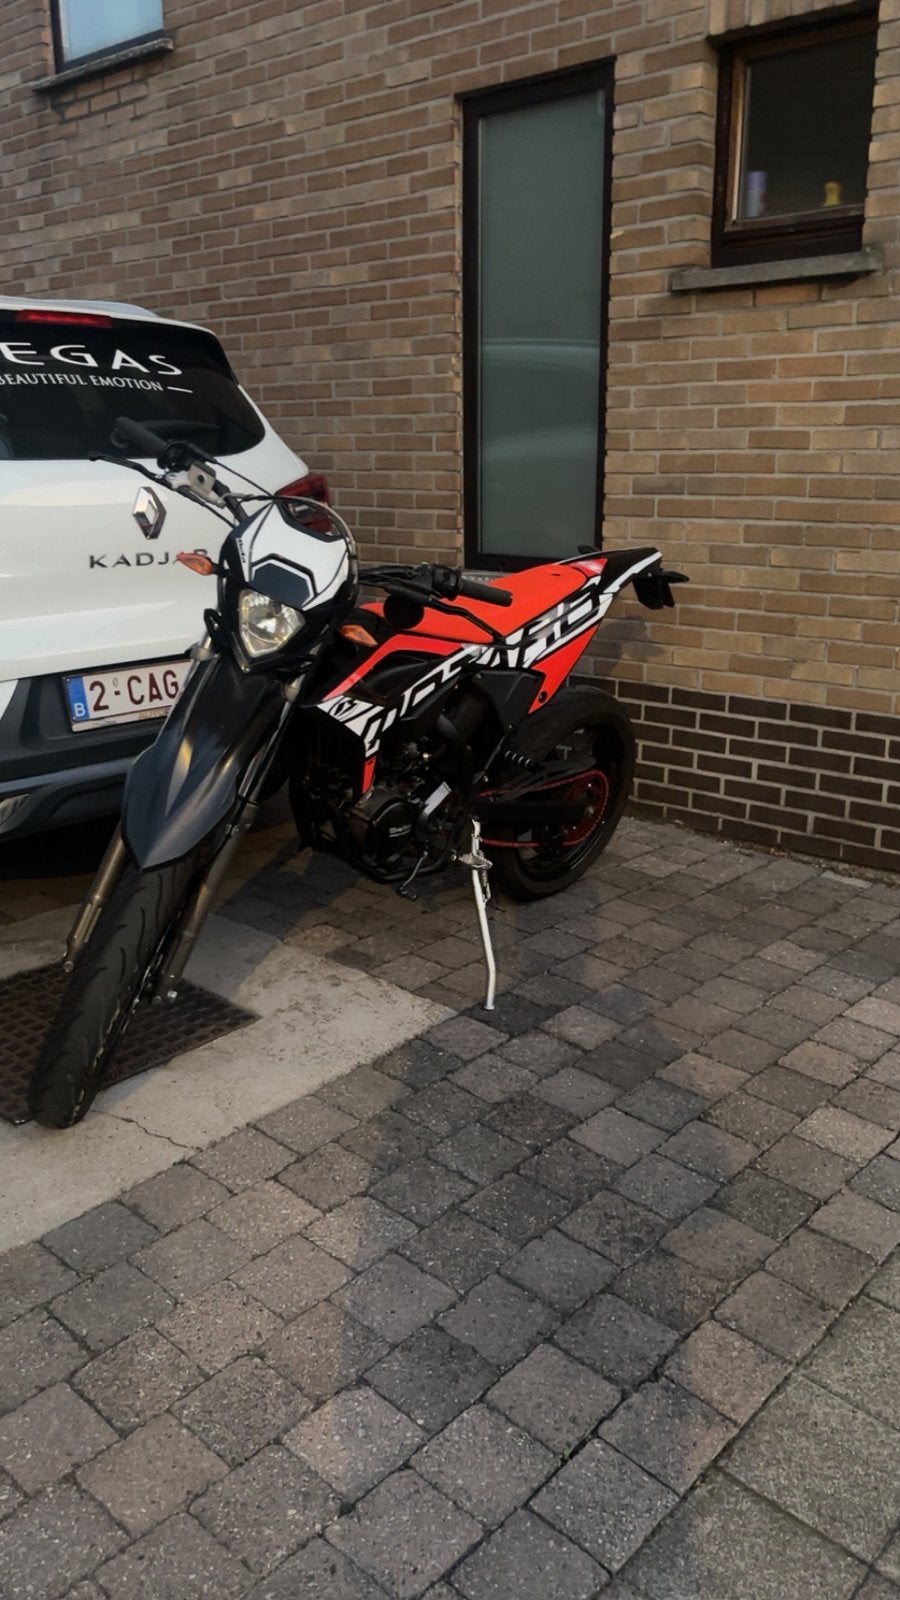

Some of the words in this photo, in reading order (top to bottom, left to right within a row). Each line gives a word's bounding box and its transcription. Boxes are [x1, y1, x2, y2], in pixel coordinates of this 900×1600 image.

[0, 342, 182, 376] EGAS
[92, 375, 164, 392] EMOTION
[89, 549, 208, 569] KADJ
[73, 702, 86, 717] B
